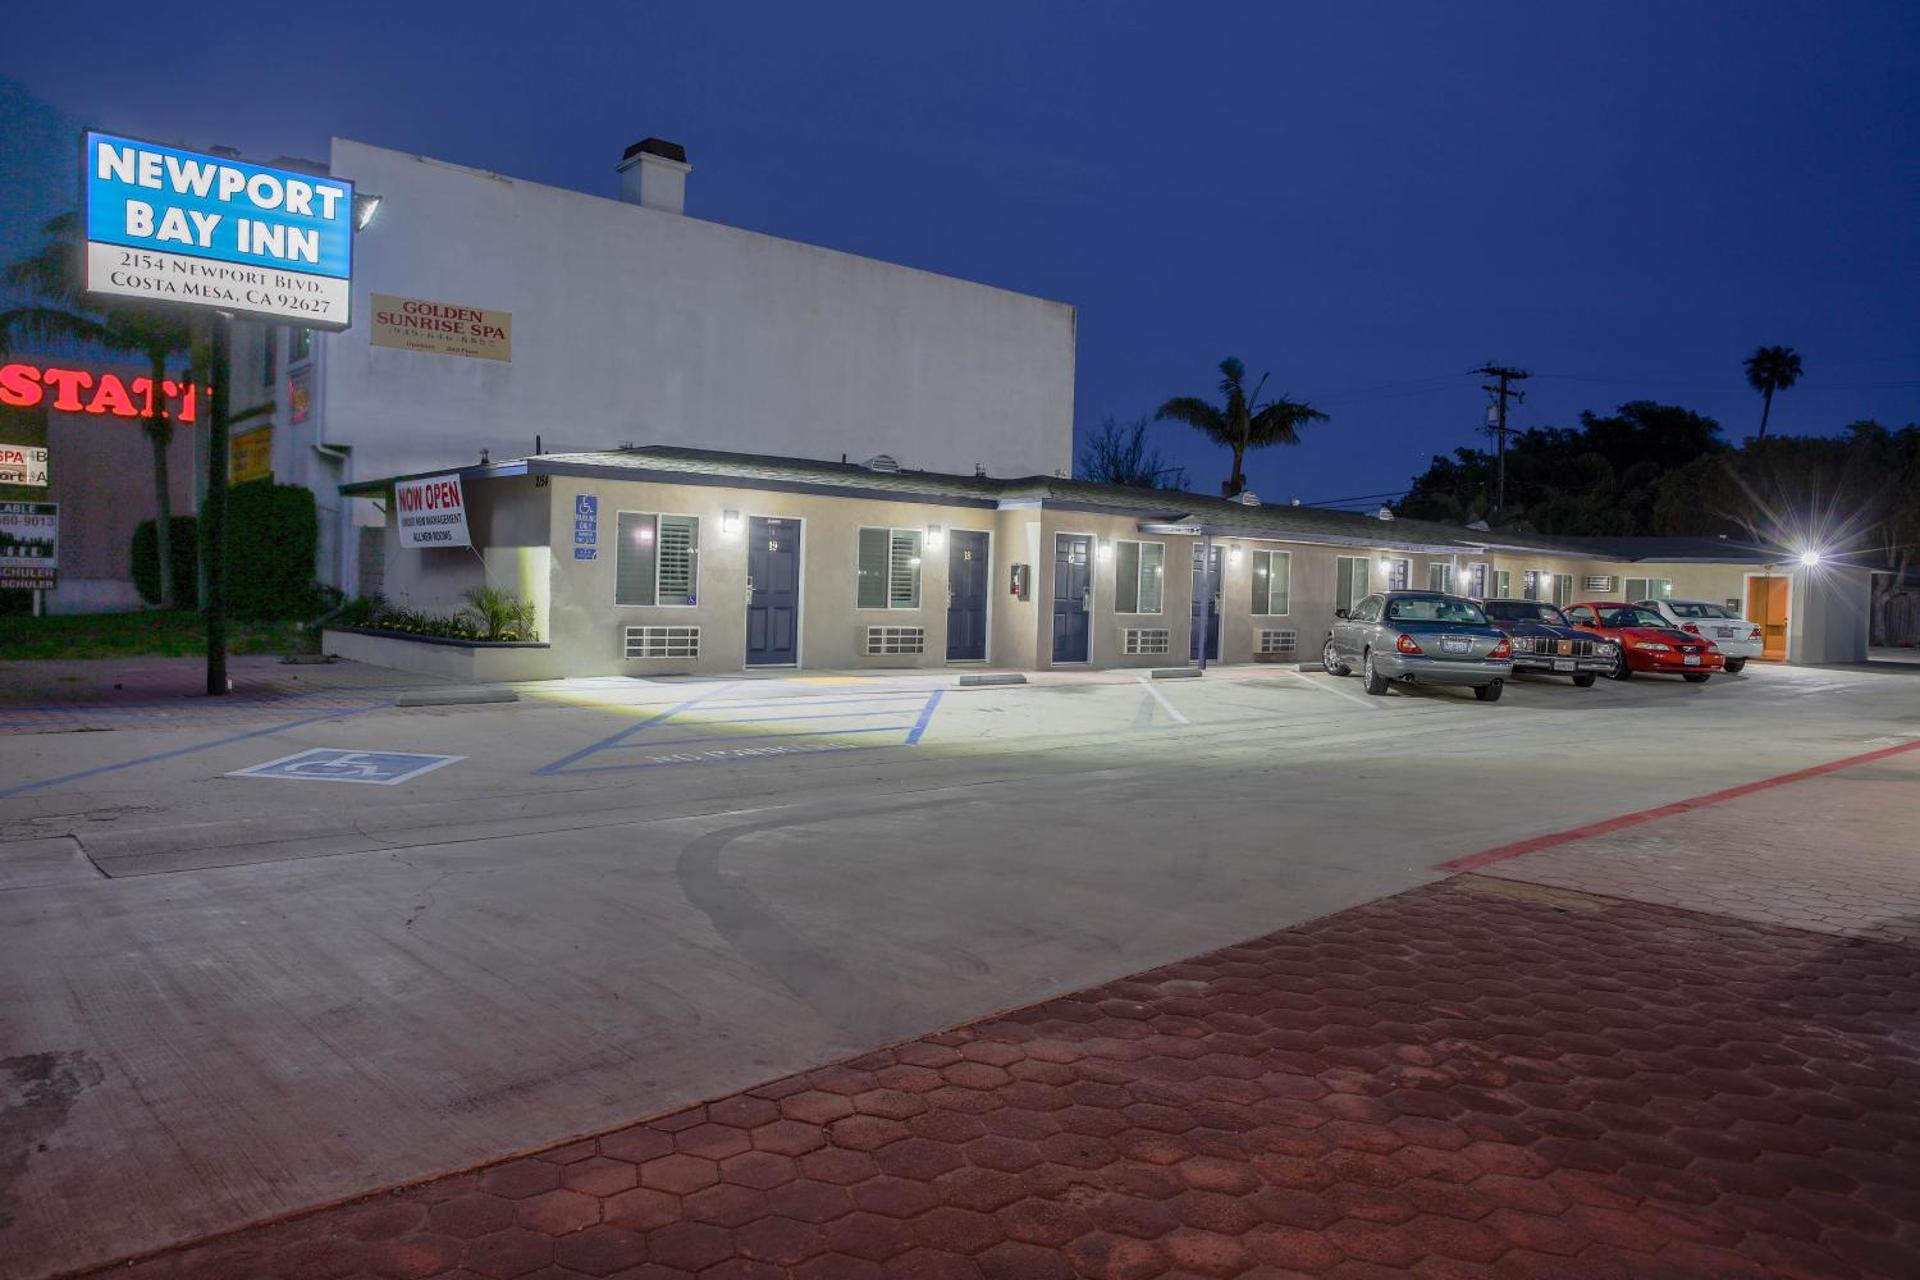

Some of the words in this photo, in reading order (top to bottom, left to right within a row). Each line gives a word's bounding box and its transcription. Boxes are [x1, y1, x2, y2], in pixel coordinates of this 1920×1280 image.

[97, 141, 344, 221] NEWPORT
[125, 199, 224, 249] BAY
[237, 218, 320, 265] INN
[120, 251, 165, 272] 2154
[172, 259, 269, 286] NEWPORT
[110, 271, 176, 294] COSTA
[183, 281, 240, 303] MESA,
[245, 290, 273, 307] CA
[277, 294, 332, 314] 92627
[375, 311, 466, 335] SUNRISE
[470, 324, 505, 340] SPA
[402, 301, 483, 323] GOLDEN
[0, 503, 37, 514] ABLE
[398, 486, 422, 512] NOW
[425, 481, 460, 510] OPEN
